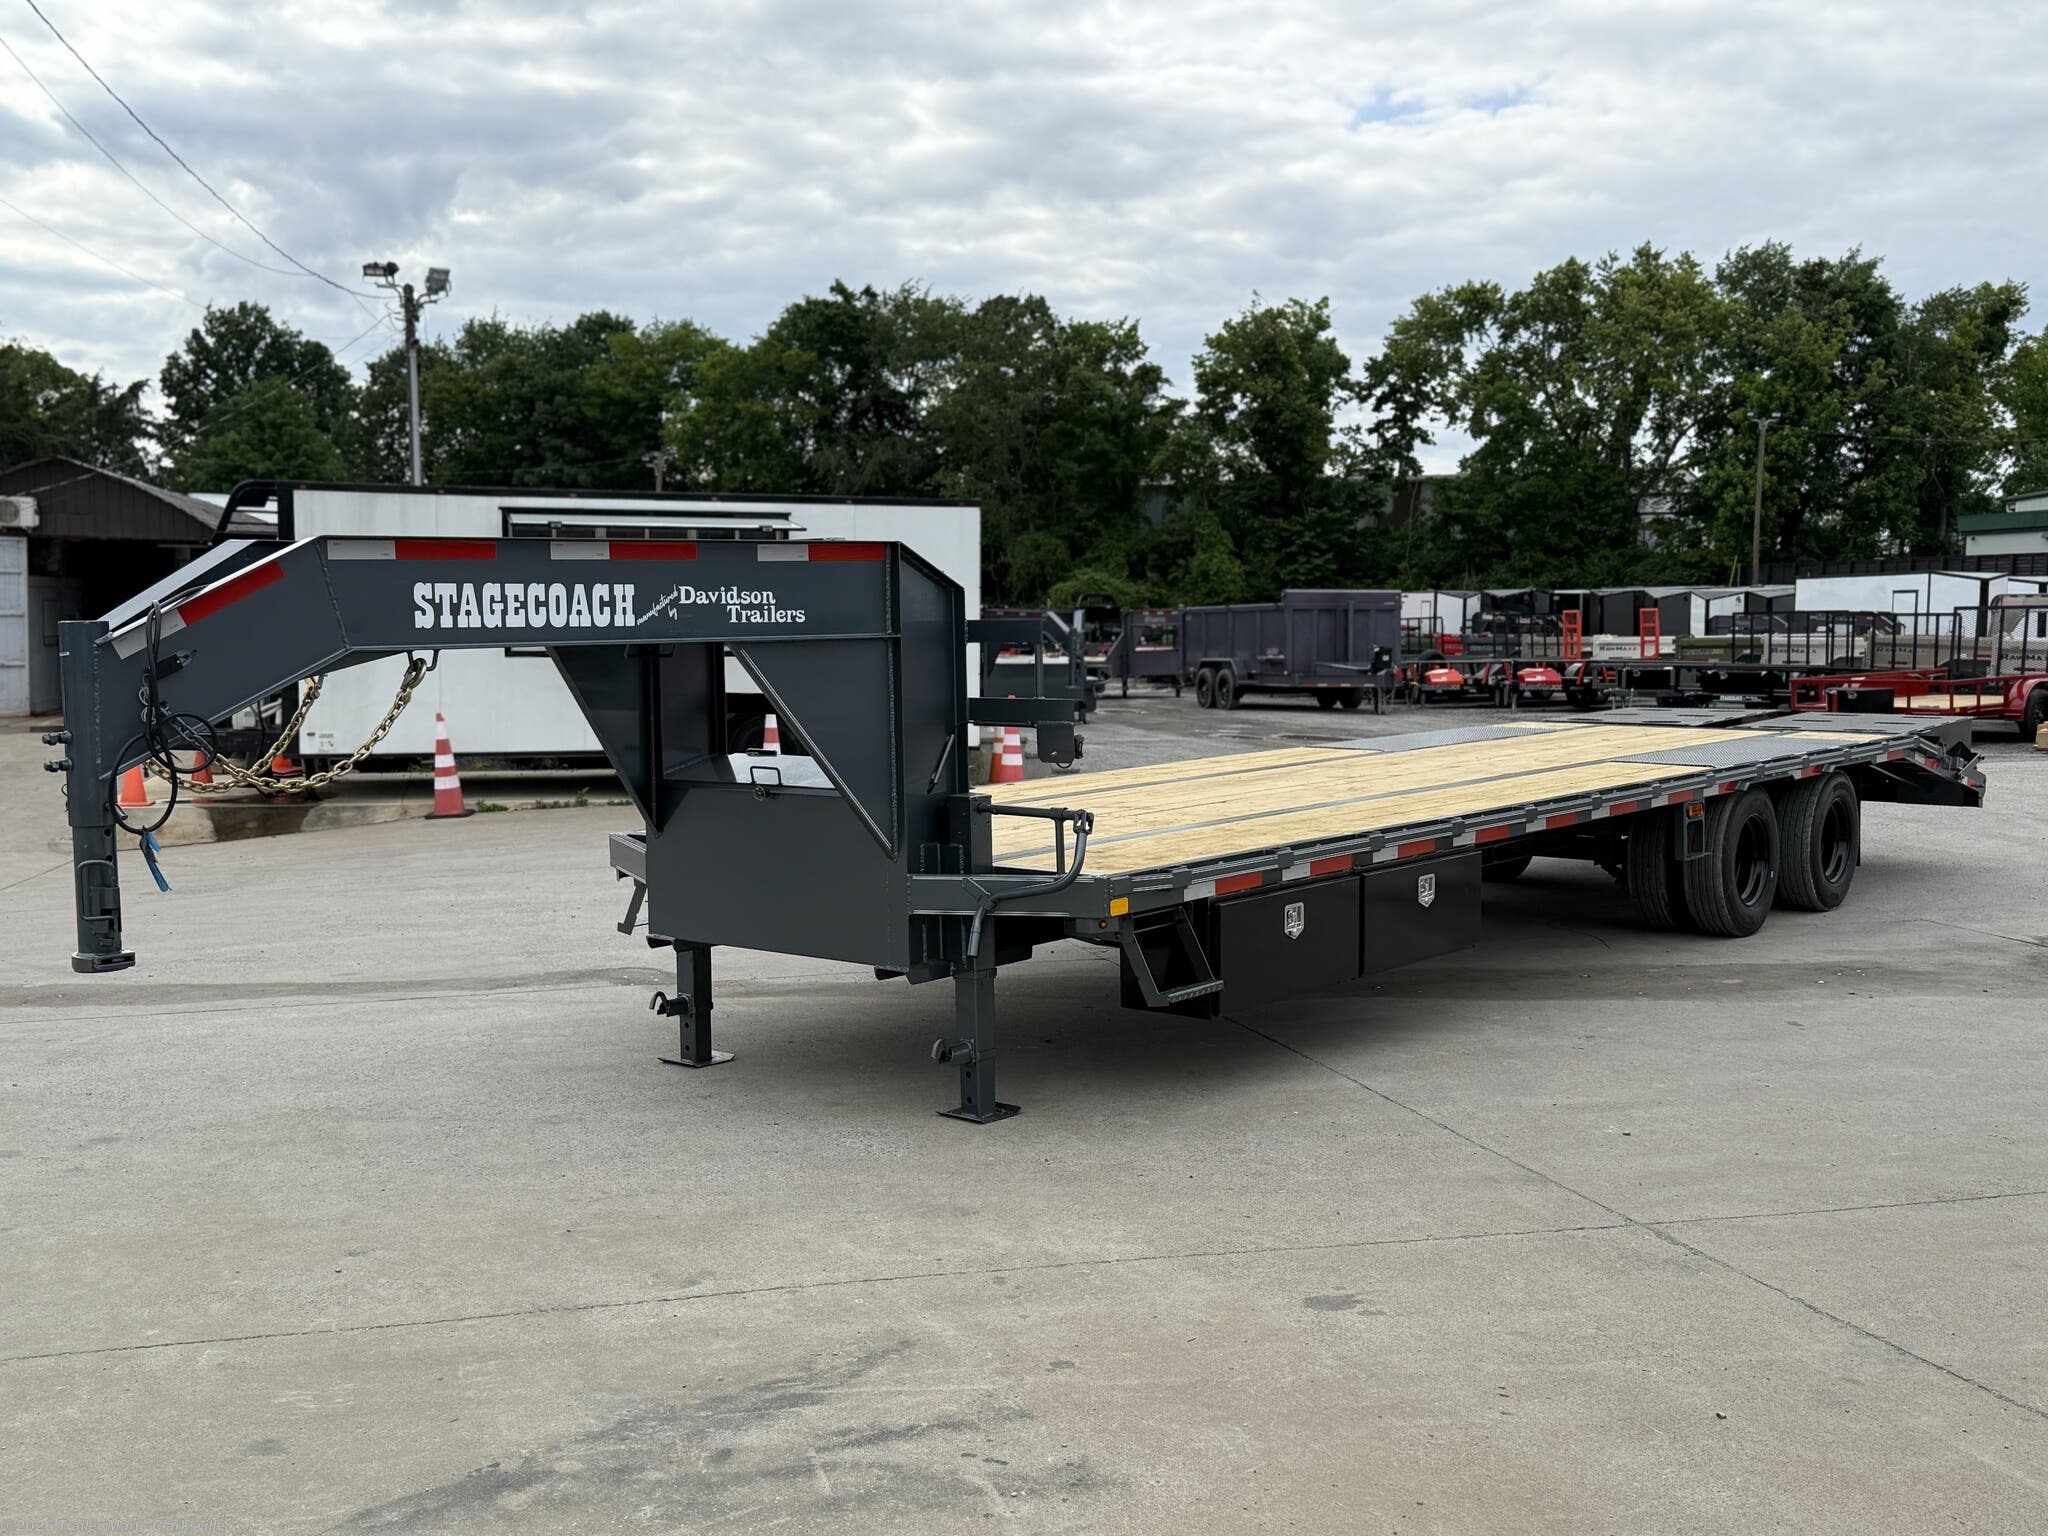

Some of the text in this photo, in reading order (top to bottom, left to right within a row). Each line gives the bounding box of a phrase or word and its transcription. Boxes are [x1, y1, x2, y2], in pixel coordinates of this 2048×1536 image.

[637, 584, 678, 625] manufactured
[678, 586, 776, 605] Davidson
[413, 582, 636, 629] STAGECOACH
[667, 605, 678, 621] by
[727, 605, 806, 624] Trailers
